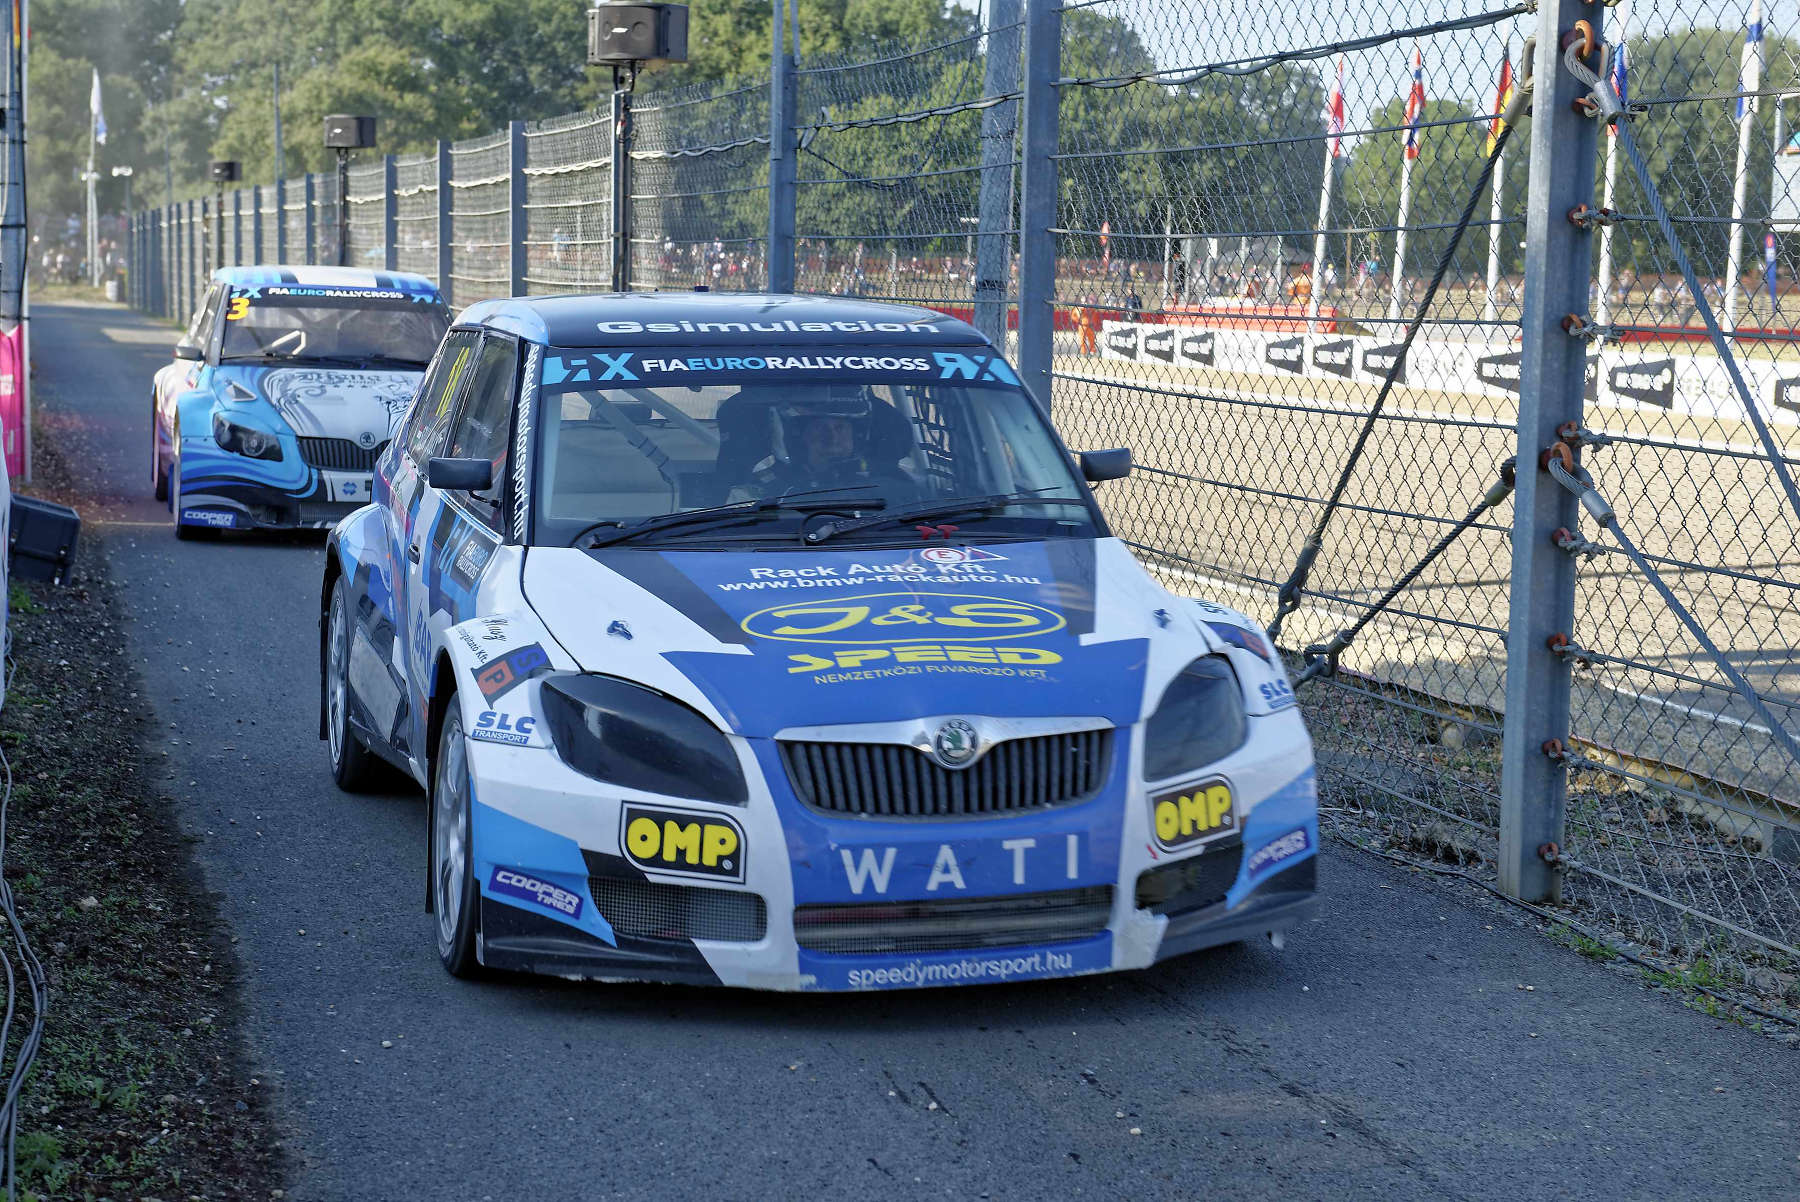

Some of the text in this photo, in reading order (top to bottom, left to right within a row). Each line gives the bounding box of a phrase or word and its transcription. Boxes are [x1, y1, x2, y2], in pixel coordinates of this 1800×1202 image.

[226, 298, 250, 321] 3
[597, 320, 941, 334] Gsimulation
[512, 342, 540, 541] speedymotorsport.hu
[184, 510, 234, 521] COOPER
[936, 550, 954, 559] E
[718, 572, 1042, 592] www.bmw-rackauto.hu
[750, 564, 838, 579] Rack
[936, 563, 998, 574] Kft.
[771, 603, 1042, 635] J&S
[786, 644, 1064, 675] SPEED
[476, 710, 537, 735] SLC
[473, 729, 529, 744] TRANSPORT
[1154, 785, 1232, 842] OMP
[627, 817, 738, 867] OMP
[496, 870, 580, 908] COOPER
[847, 951, 1073, 986] speedymotorsport.hu
